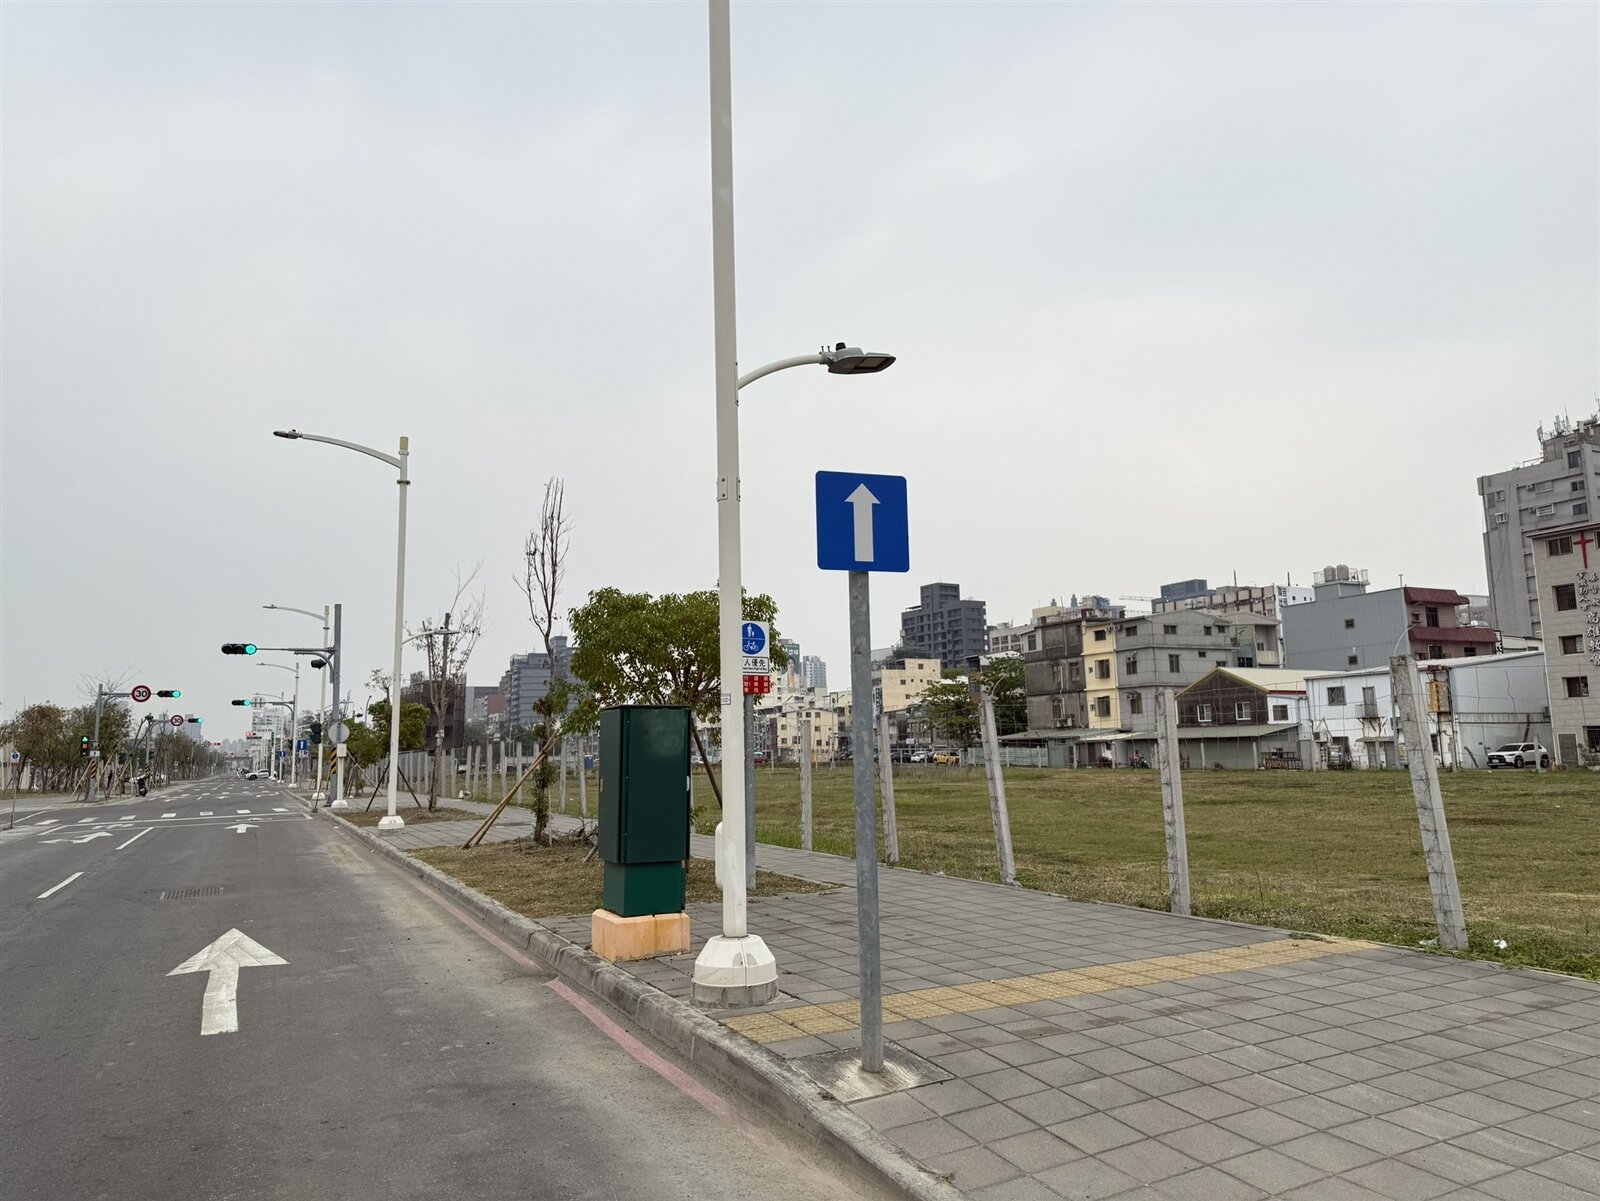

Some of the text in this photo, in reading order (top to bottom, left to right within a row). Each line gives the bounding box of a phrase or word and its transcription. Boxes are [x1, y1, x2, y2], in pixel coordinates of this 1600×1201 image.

[744, 658, 766, 667] 人優先
[136, 690, 148, 698] 30
